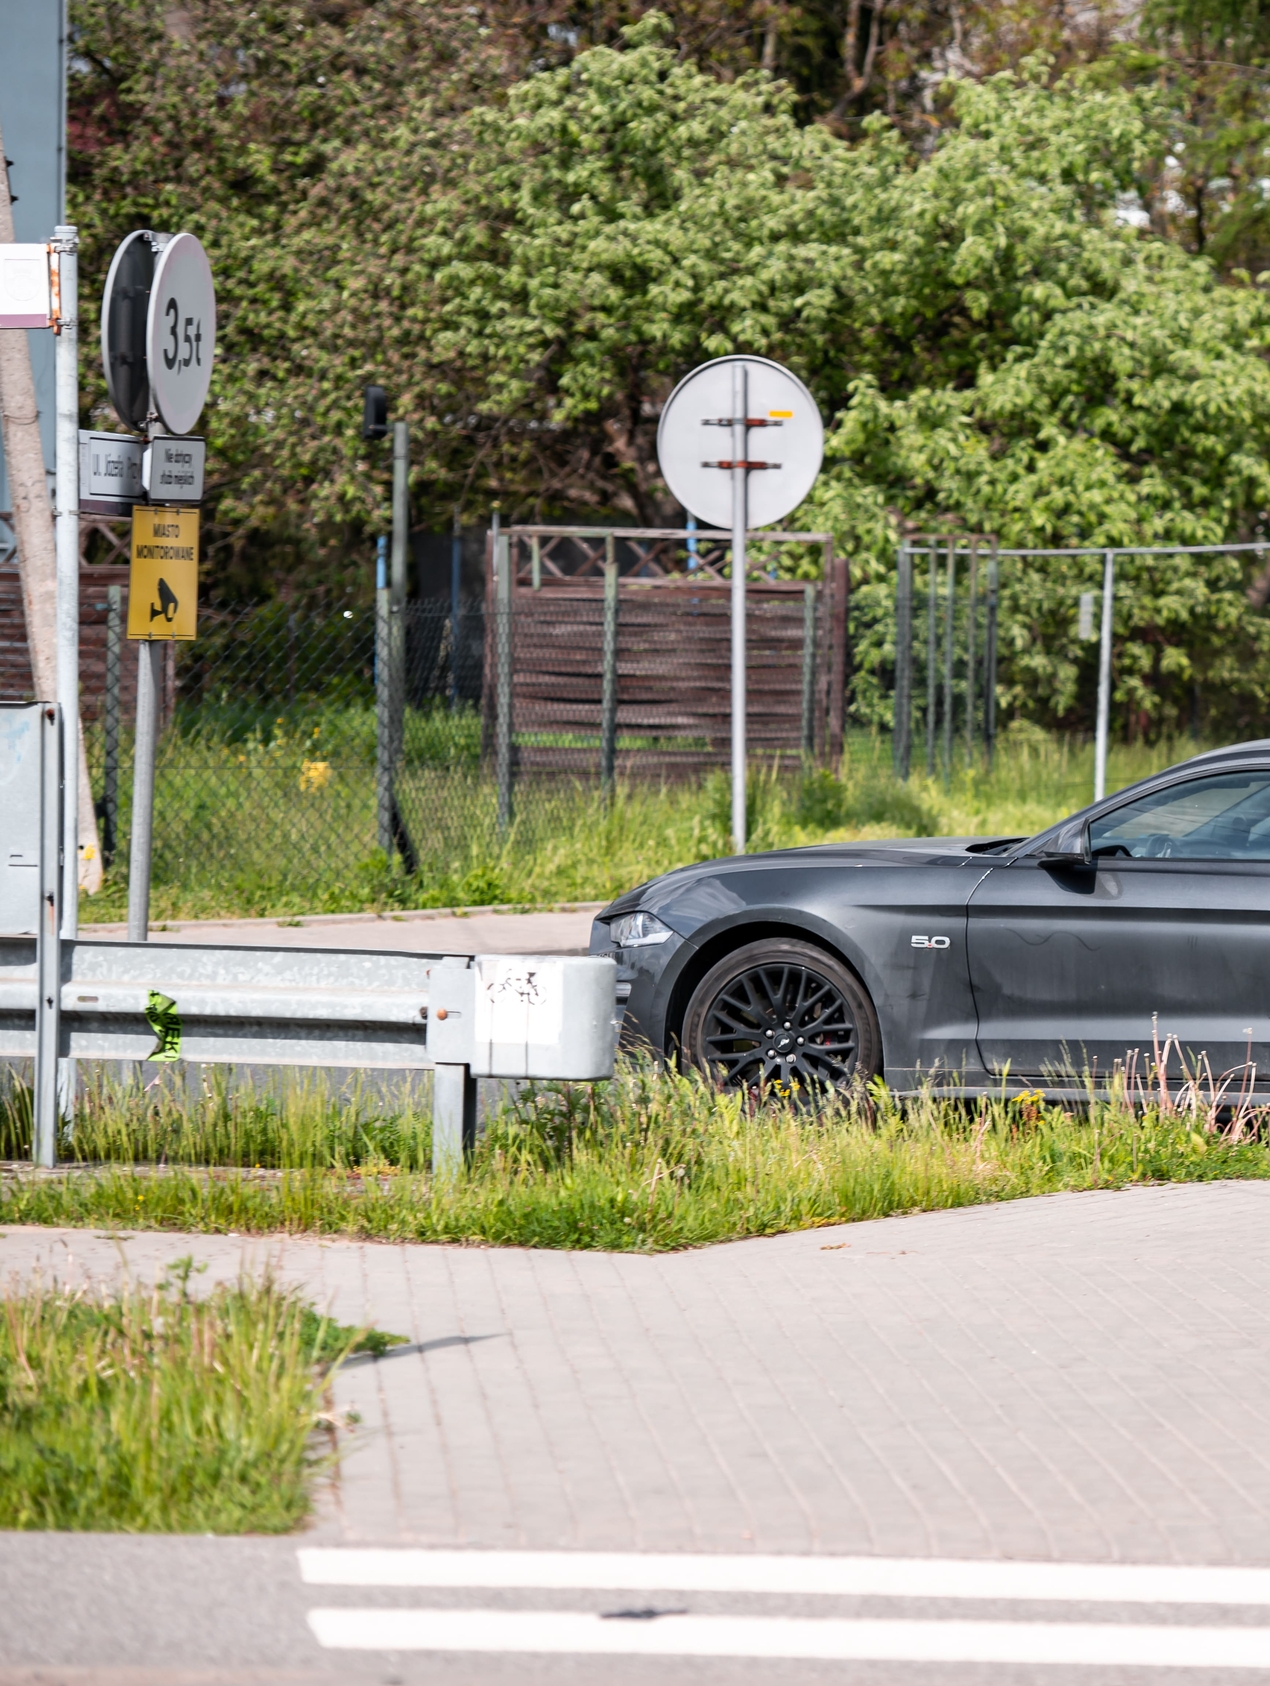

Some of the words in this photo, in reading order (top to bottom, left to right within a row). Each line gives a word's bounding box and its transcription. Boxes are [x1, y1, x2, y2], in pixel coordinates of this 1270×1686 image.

[163, 297, 202, 376] 3,5t
[153, 523, 180, 538] MIASTO
[136, 544, 194, 561] MONITOROWANE
[910, 935, 951, 949] 5.0
